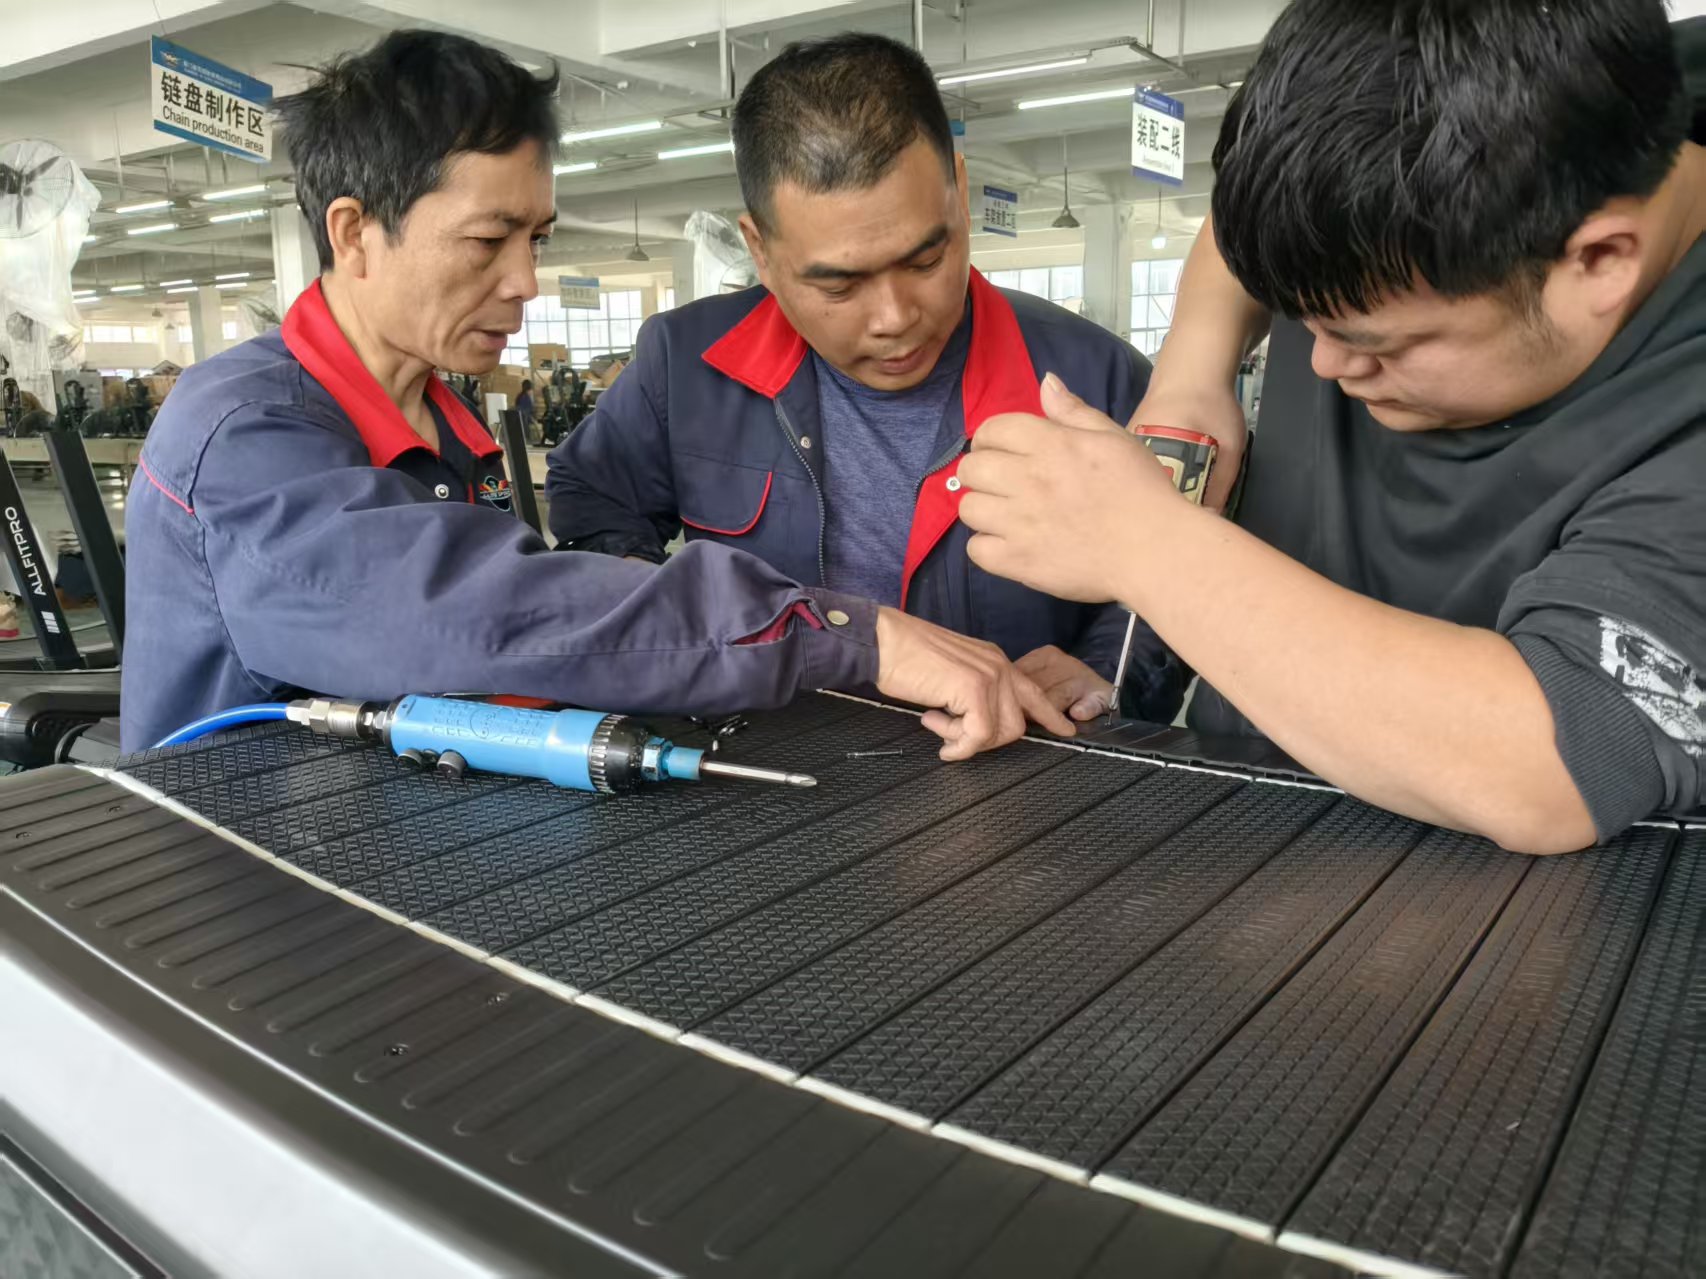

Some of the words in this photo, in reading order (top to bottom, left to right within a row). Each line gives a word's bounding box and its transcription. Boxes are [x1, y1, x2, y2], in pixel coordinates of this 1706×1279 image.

[161, 71, 264, 137] 链盘制作区
[162, 105, 190, 127] Chain
[192, 118, 243, 147] production
[244, 138, 264, 153] area
[4, 506, 47, 596] ALLFITPRO
